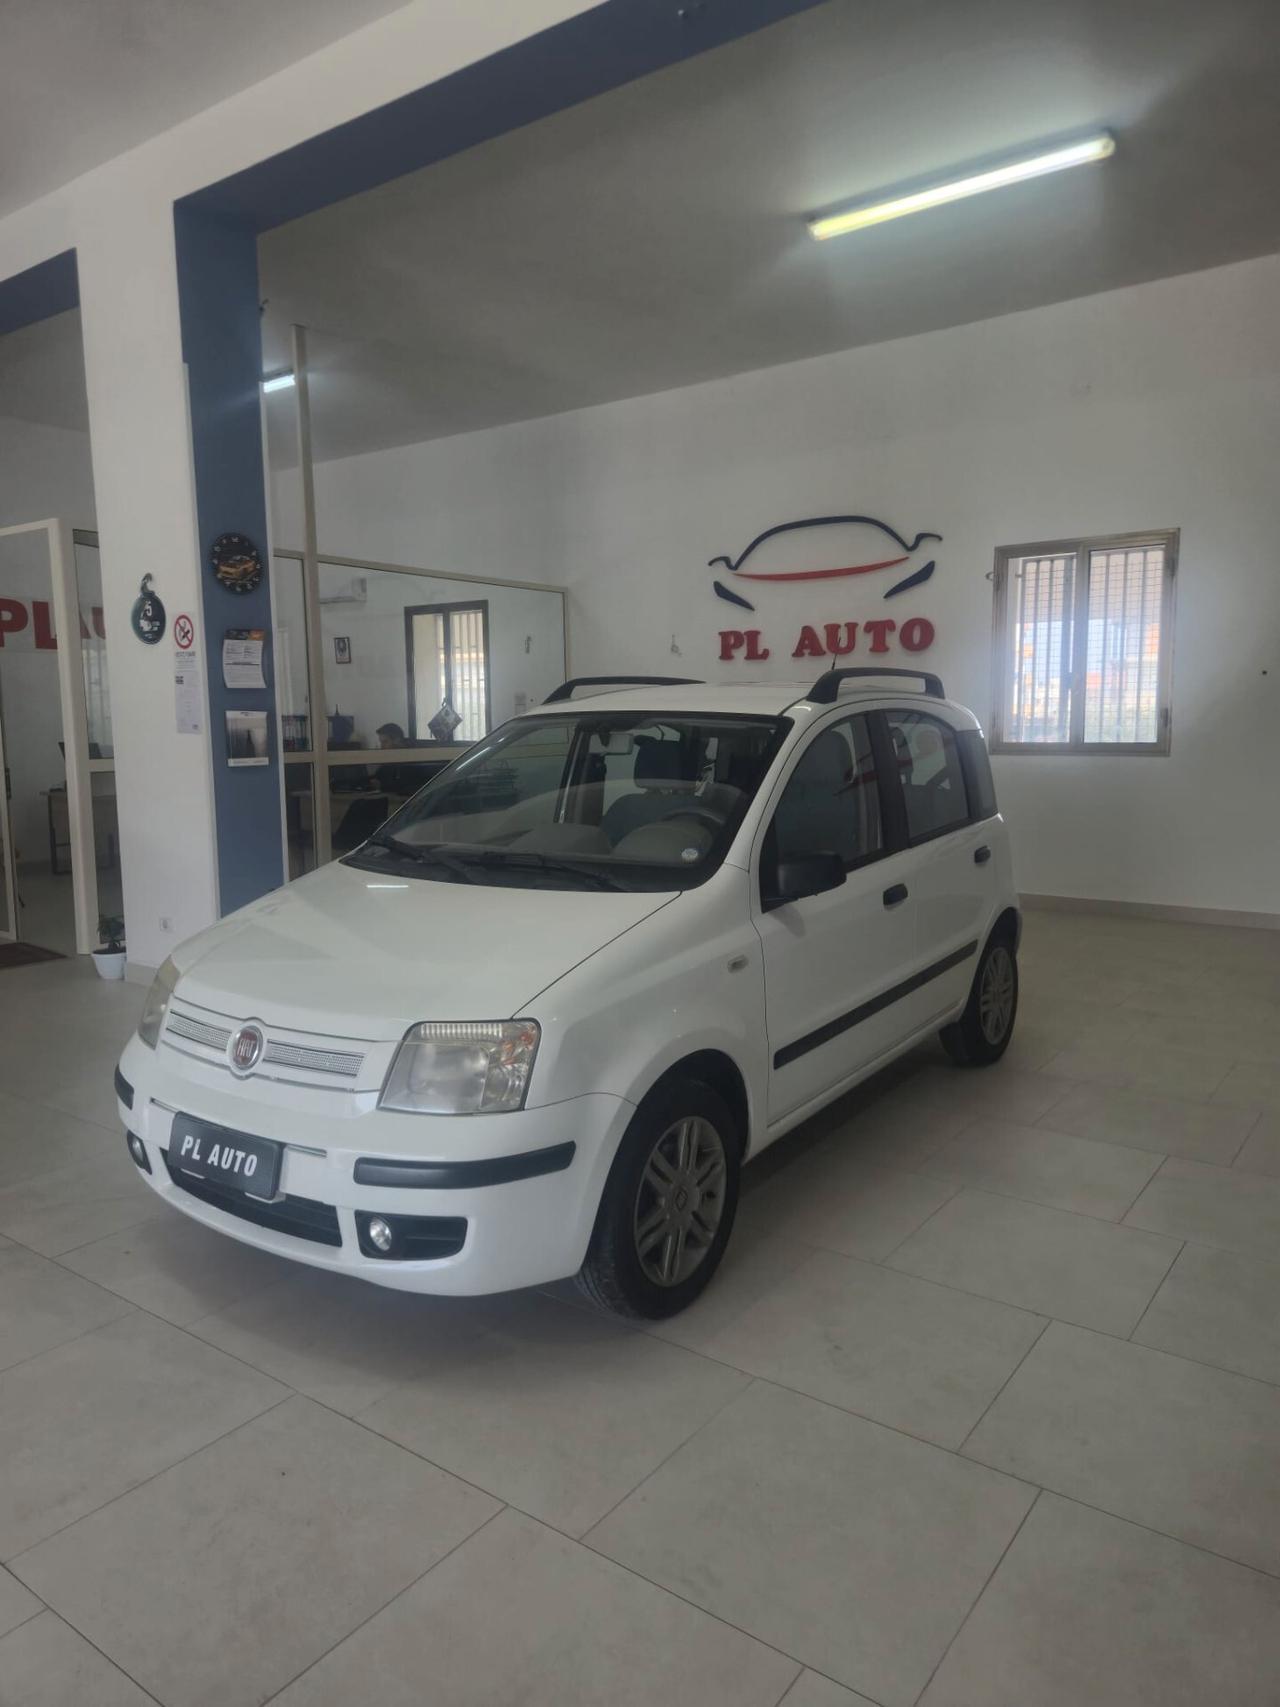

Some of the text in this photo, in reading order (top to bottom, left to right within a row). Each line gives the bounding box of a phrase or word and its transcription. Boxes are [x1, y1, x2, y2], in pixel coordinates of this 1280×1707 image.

[0, 598, 58, 650] PL
[718, 618, 935, 660] PL AUTO
[181, 1135, 258, 1177] PL AUTO
